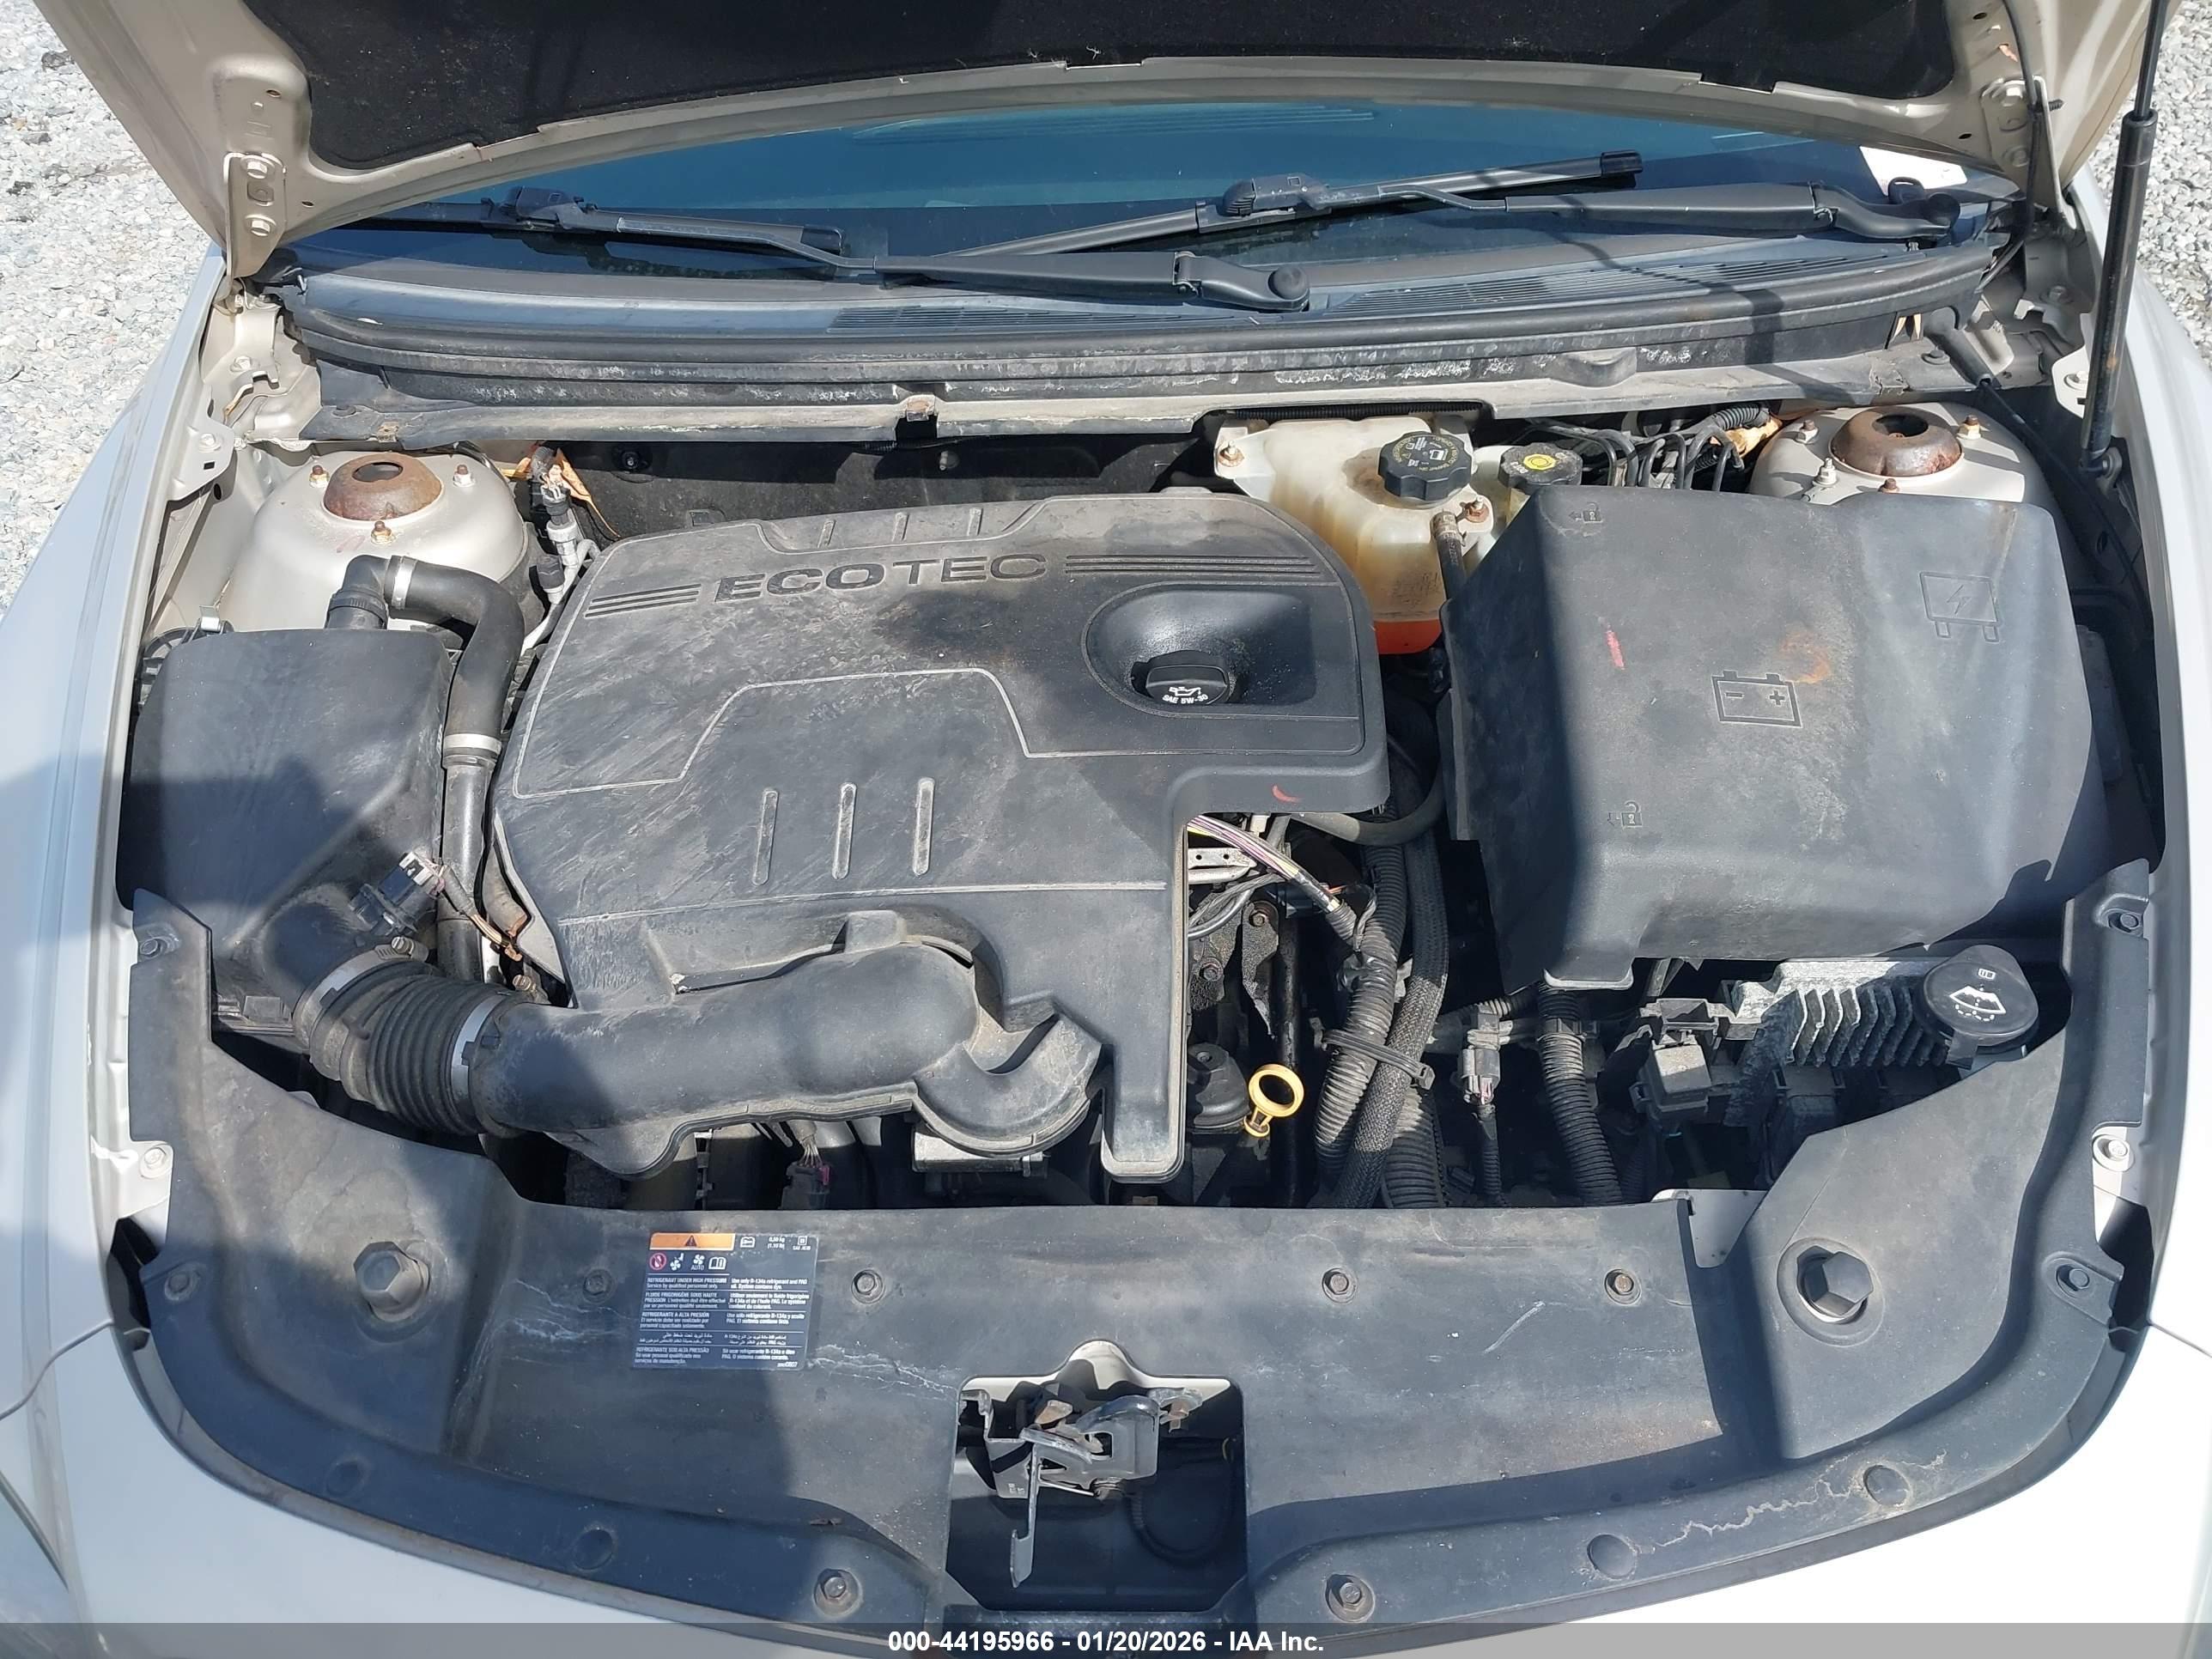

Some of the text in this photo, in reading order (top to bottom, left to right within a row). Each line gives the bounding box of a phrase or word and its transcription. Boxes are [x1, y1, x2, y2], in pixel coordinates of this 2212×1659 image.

[714, 554, 1048, 603] ECOTEC
[1162, 694, 1209, 705] SAE 5W-30
